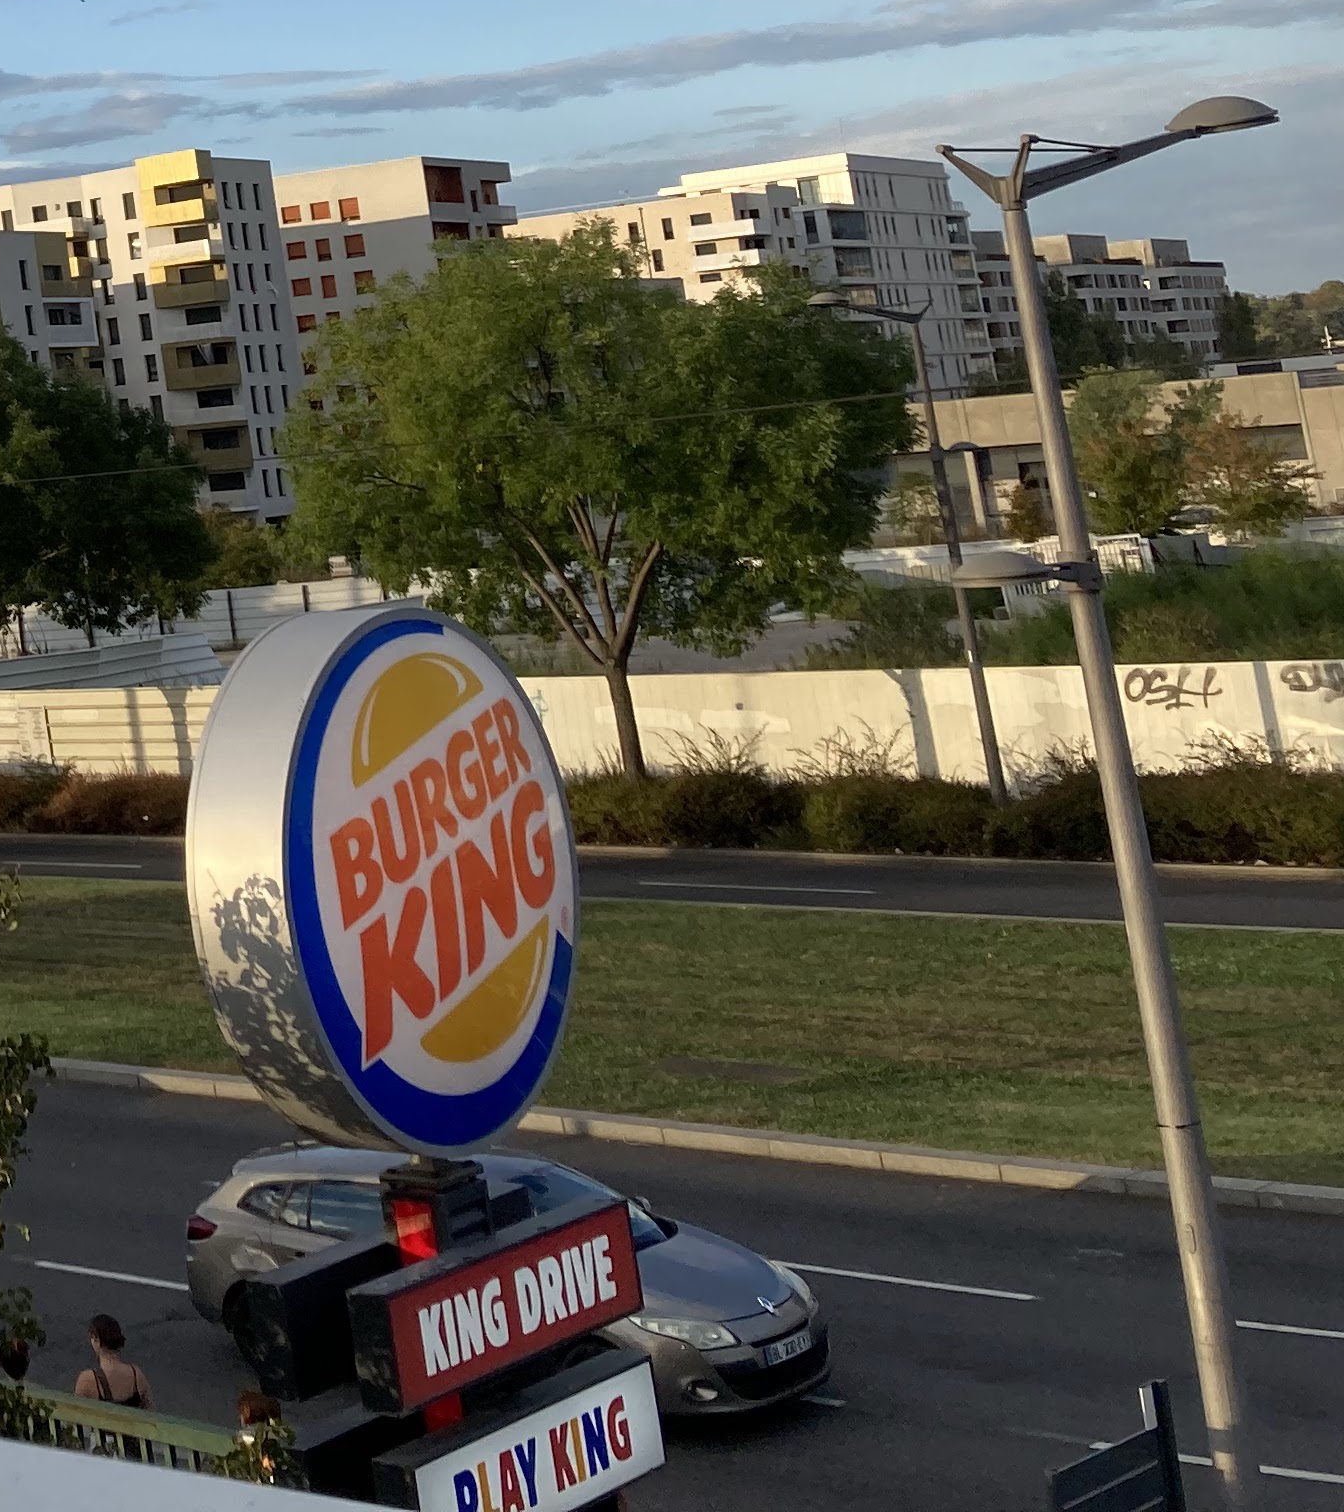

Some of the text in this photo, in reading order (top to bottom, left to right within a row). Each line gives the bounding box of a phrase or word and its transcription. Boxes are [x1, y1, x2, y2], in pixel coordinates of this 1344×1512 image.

[330, 698, 531, 932] BURGER
[360, 780, 555, 1065] KING
[418, 1234, 617, 1378] KING DRIVE
[453, 1395, 633, 1512] PLAY KING
